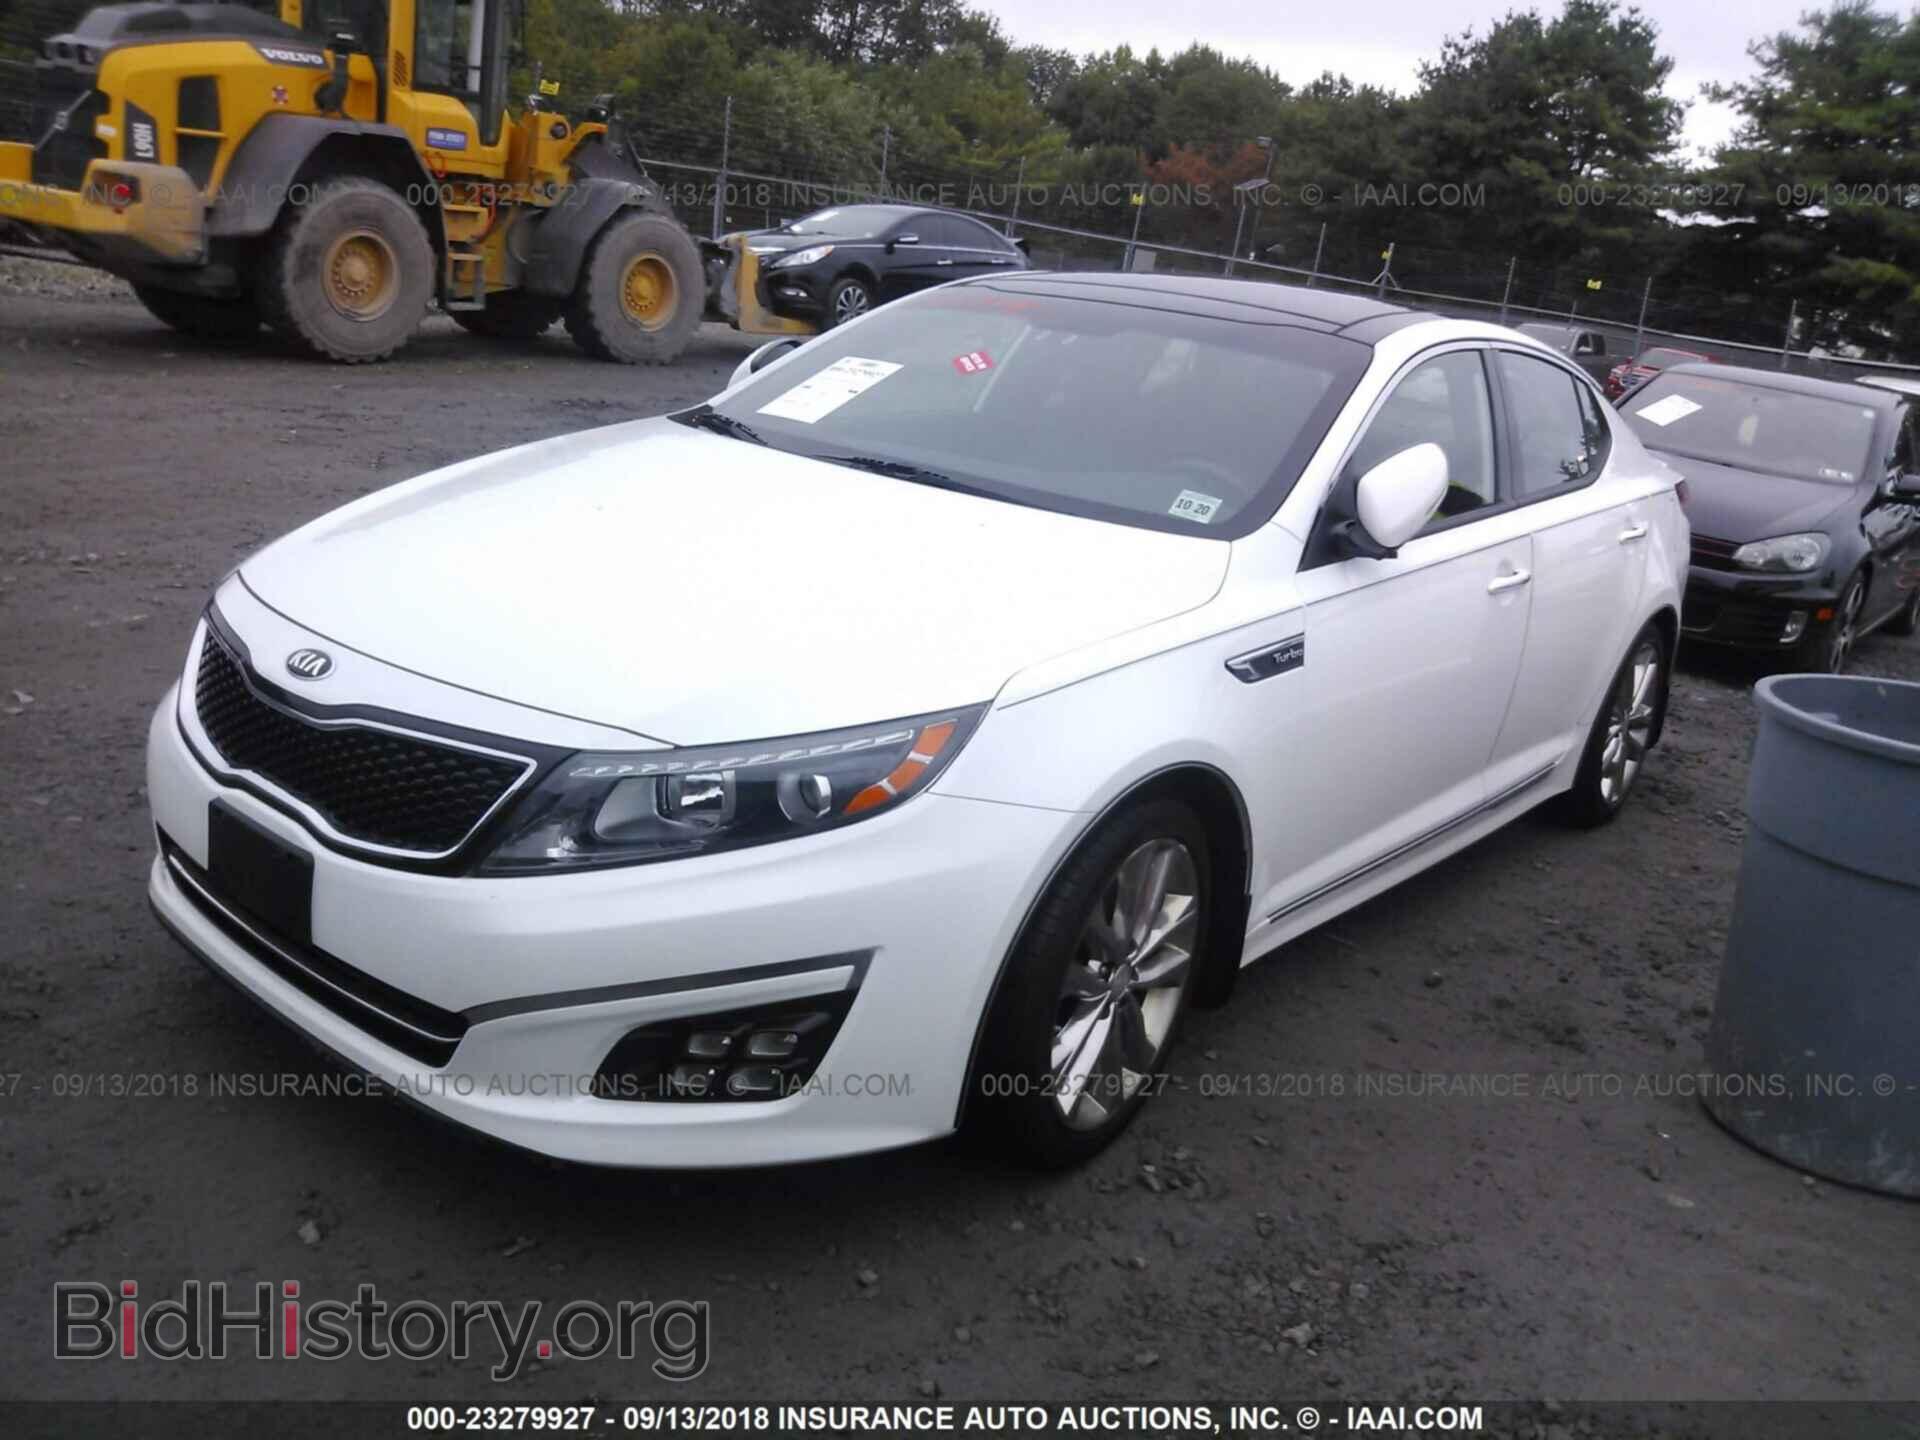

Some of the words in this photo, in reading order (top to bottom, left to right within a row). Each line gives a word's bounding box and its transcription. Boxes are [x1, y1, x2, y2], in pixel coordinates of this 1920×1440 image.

[260, 48, 324, 65] VOLVO
[288, 650, 329, 677] KIA
[1272, 647, 1304, 664] Turbo
